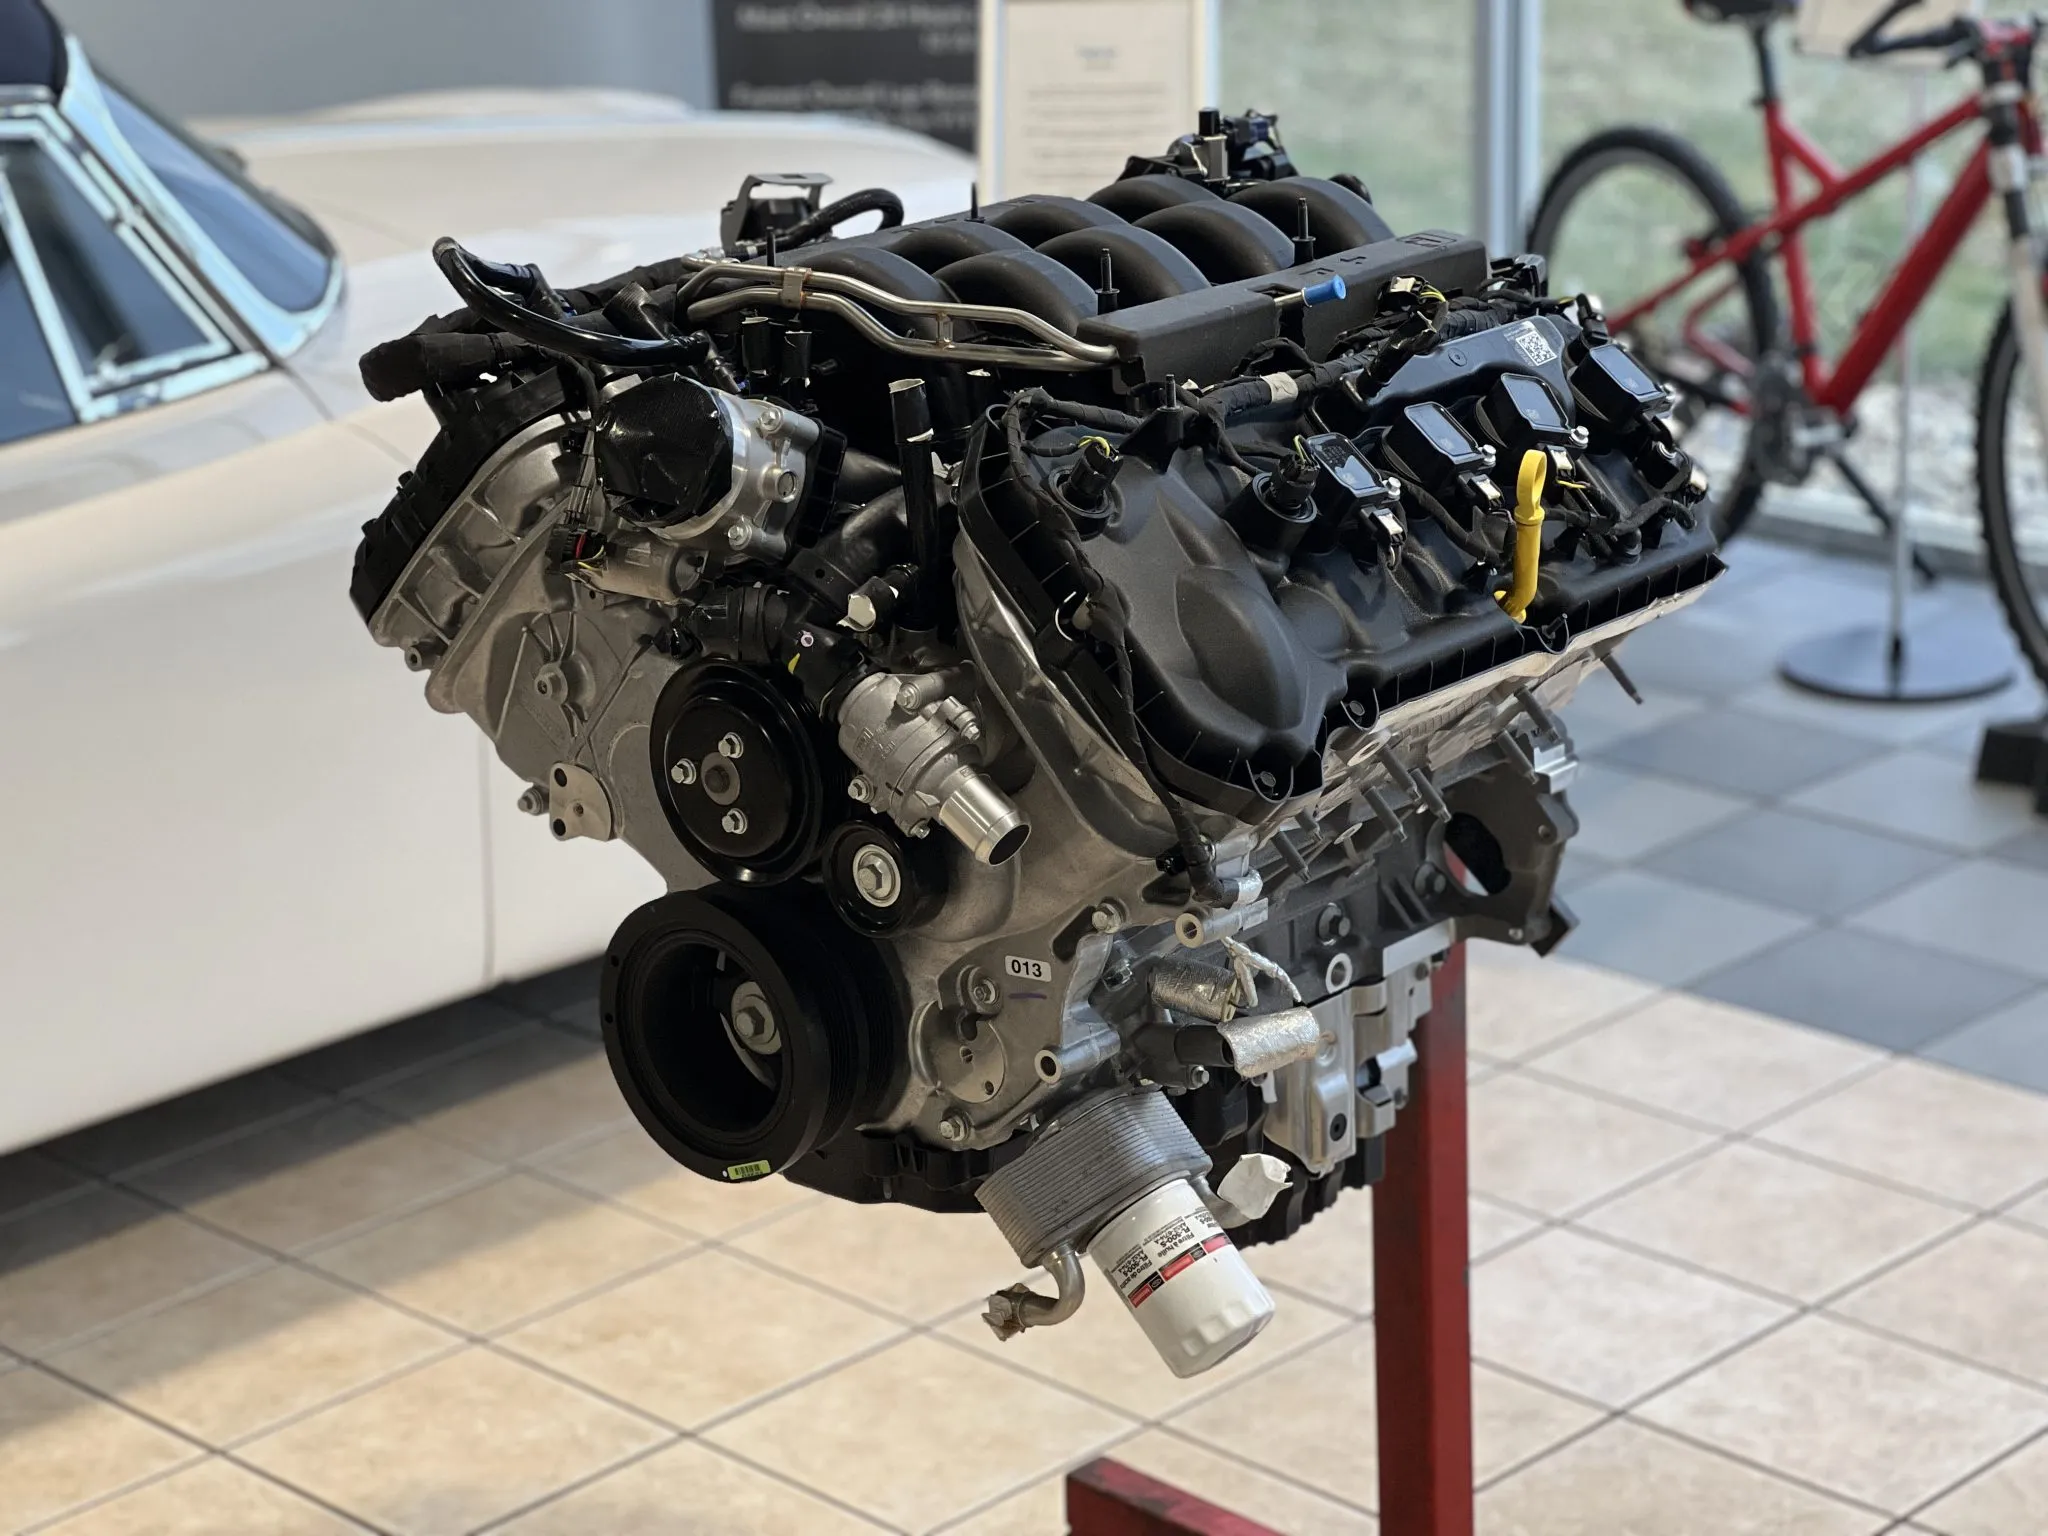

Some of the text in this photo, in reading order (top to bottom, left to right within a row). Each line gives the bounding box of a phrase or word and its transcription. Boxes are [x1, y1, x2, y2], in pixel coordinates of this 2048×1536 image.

[1011, 959, 1042, 978] 013
[1159, 1225, 1190, 1247] FL-500-S
[1177, 1231, 1195, 1244] Filtre
[1156, 1244, 1174, 1258] huile
[1122, 1253, 1148, 1277] FL-500-S
[1136, 1259, 1152, 1274] Filtro
